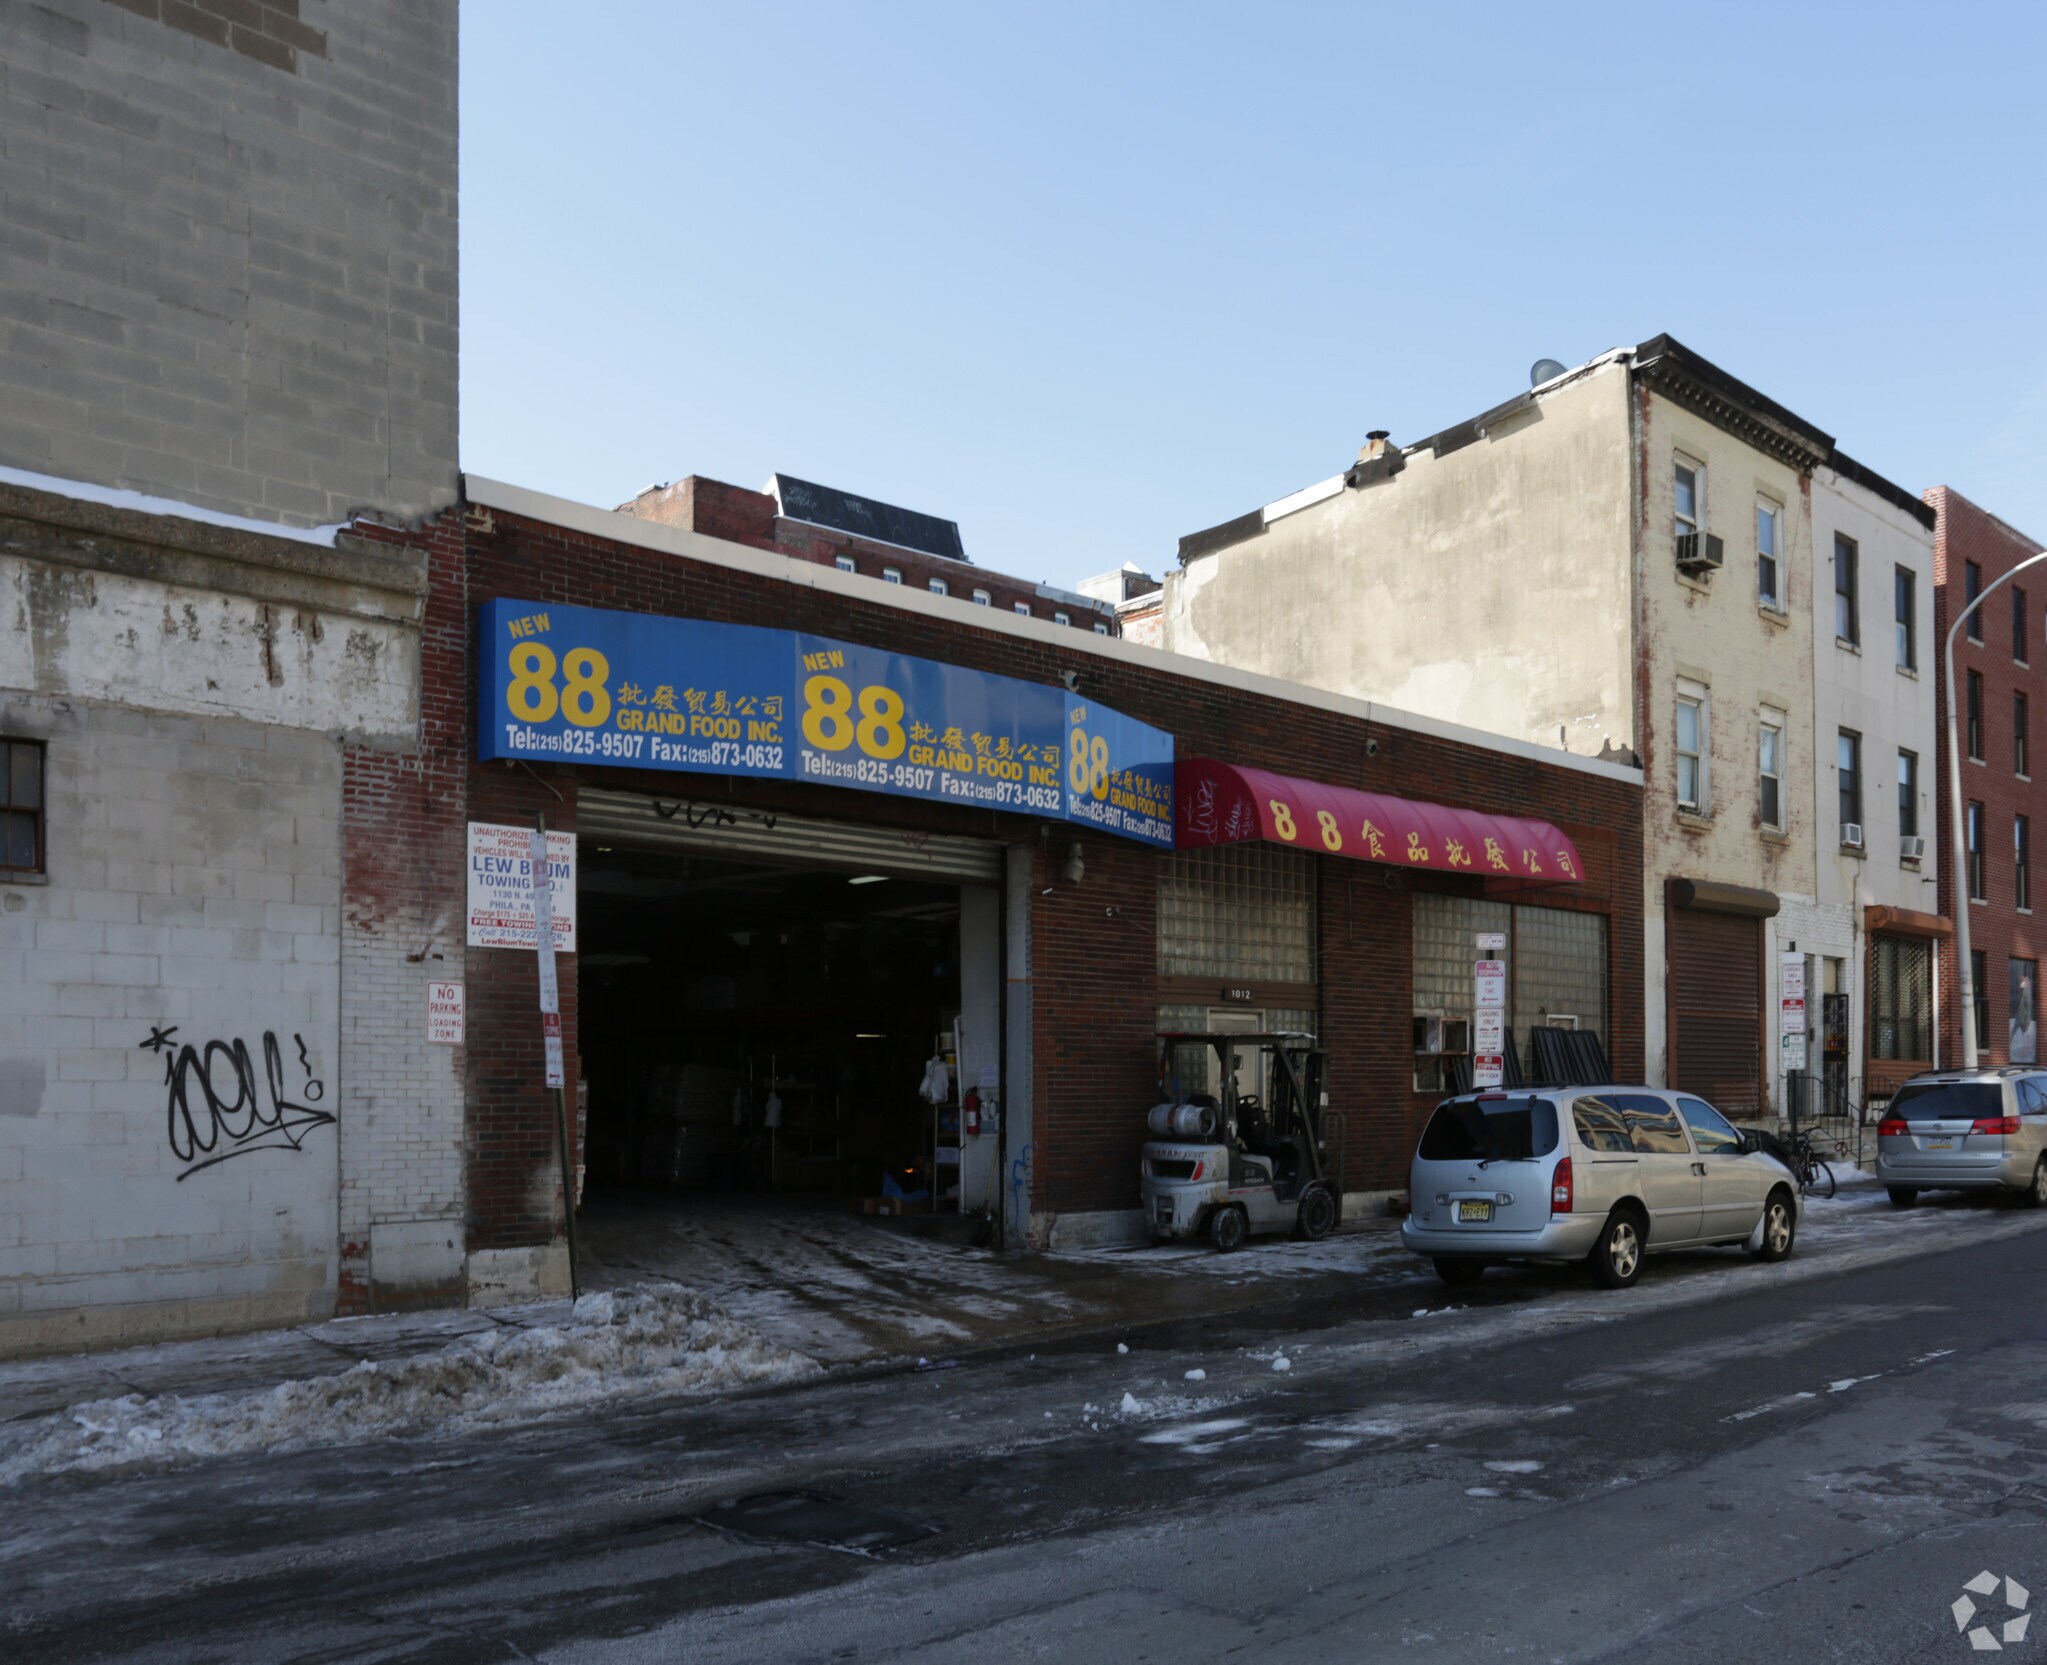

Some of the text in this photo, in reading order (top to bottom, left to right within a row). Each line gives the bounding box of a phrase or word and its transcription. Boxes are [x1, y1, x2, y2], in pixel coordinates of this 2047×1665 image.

[508, 612, 551, 639] NEW
[803, 650, 844, 672] NEW
[506, 641, 611, 727] 88
[617, 681, 783, 721] 批發貿易公司
[802, 675, 906, 759] 88
[1069, 705, 1086, 725] NEW
[617, 709, 783, 743] GRAND FOOD INC.
[910, 721, 1060, 767] 批發貿易公司
[909, 744, 1060, 788] GRAND FOOD INC.
[1069, 727, 1109, 800] 88
[1110, 787, 1136, 810] GRAND
[1137, 797, 1157, 816] FOOD
[473, 827, 530, 840] UNAUTHORIZE
[473, 846, 507, 857] VEHICLES
[509, 849, 524, 859] WILL
[561, 855, 570, 863] BY
[473, 855, 513, 873] LEW
[478, 873, 530, 889] TOWING
[493, 890, 512, 898] 1130
[514, 891, 522, 899] N.
[473, 908, 495, 918] Charge
[521, 902, 530, 911] PA
[474, 917, 498, 926] FREE
[478, 926, 496, 937] Call
[437, 988, 454, 1000] NO
[1231, 989, 1250, 1000] 1012
[430, 1002, 461, 1015] PARKING
[429, 1017, 462, 1027] LOADING
[435, 1030, 455, 1039] ZONE
